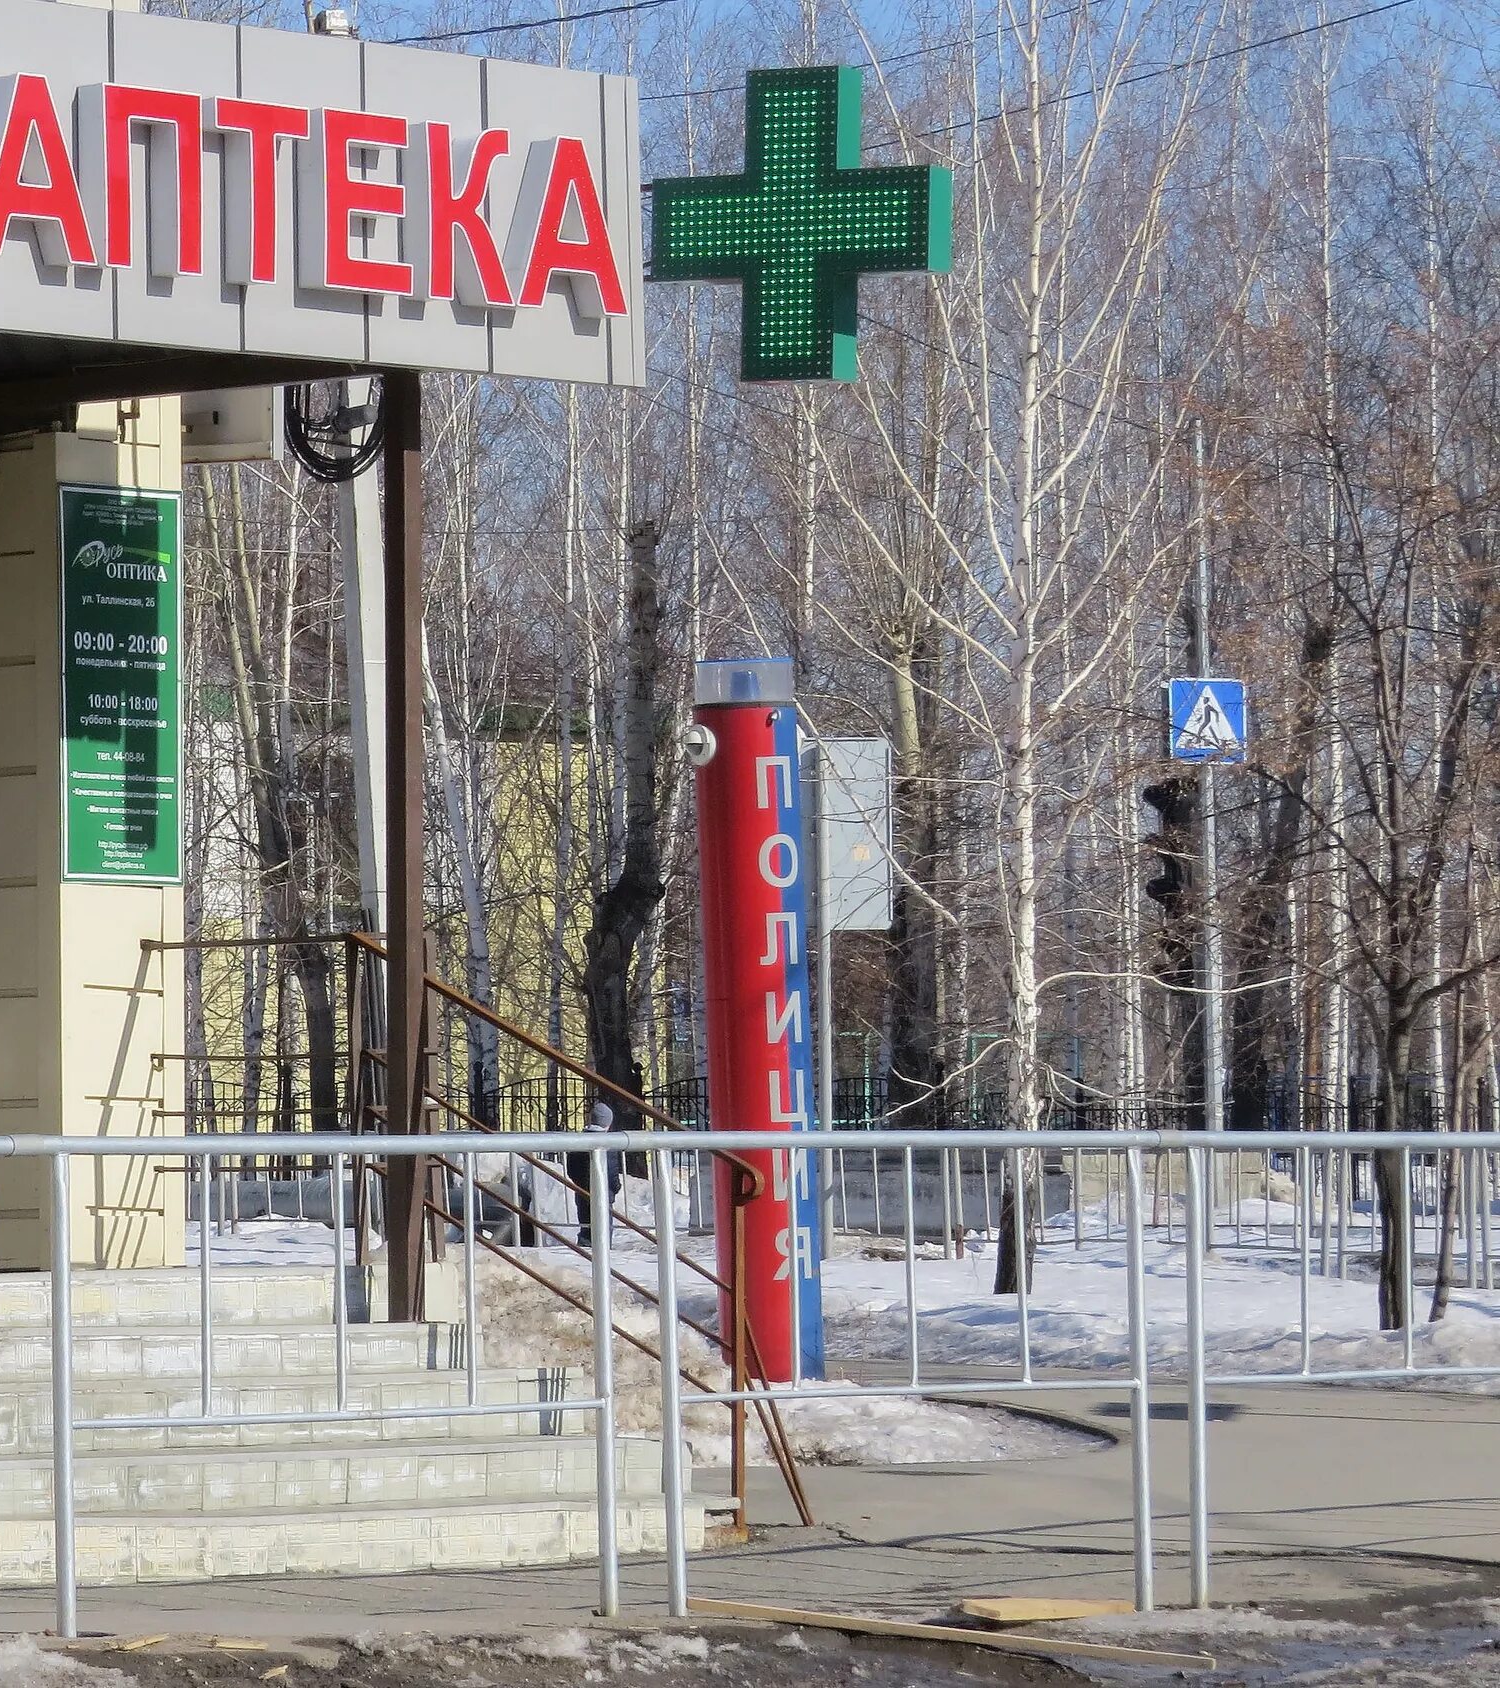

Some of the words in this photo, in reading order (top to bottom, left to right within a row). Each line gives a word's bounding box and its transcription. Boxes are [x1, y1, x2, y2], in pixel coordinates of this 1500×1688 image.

[106, 562, 168, 583] ОПТИКА
[74, 631, 114, 652] 09:00
[128, 635, 168, 655] 20:00
[134, 660, 166, 671] пятница
[88, 694, 118, 709] 10:00
[128, 696, 158, 711] 18:00
[80, 714, 112, 727] суббота
[118, 717, 167, 729] воскресенье
[755, 755, 814, 1281] ПОЛИЦИЯ
